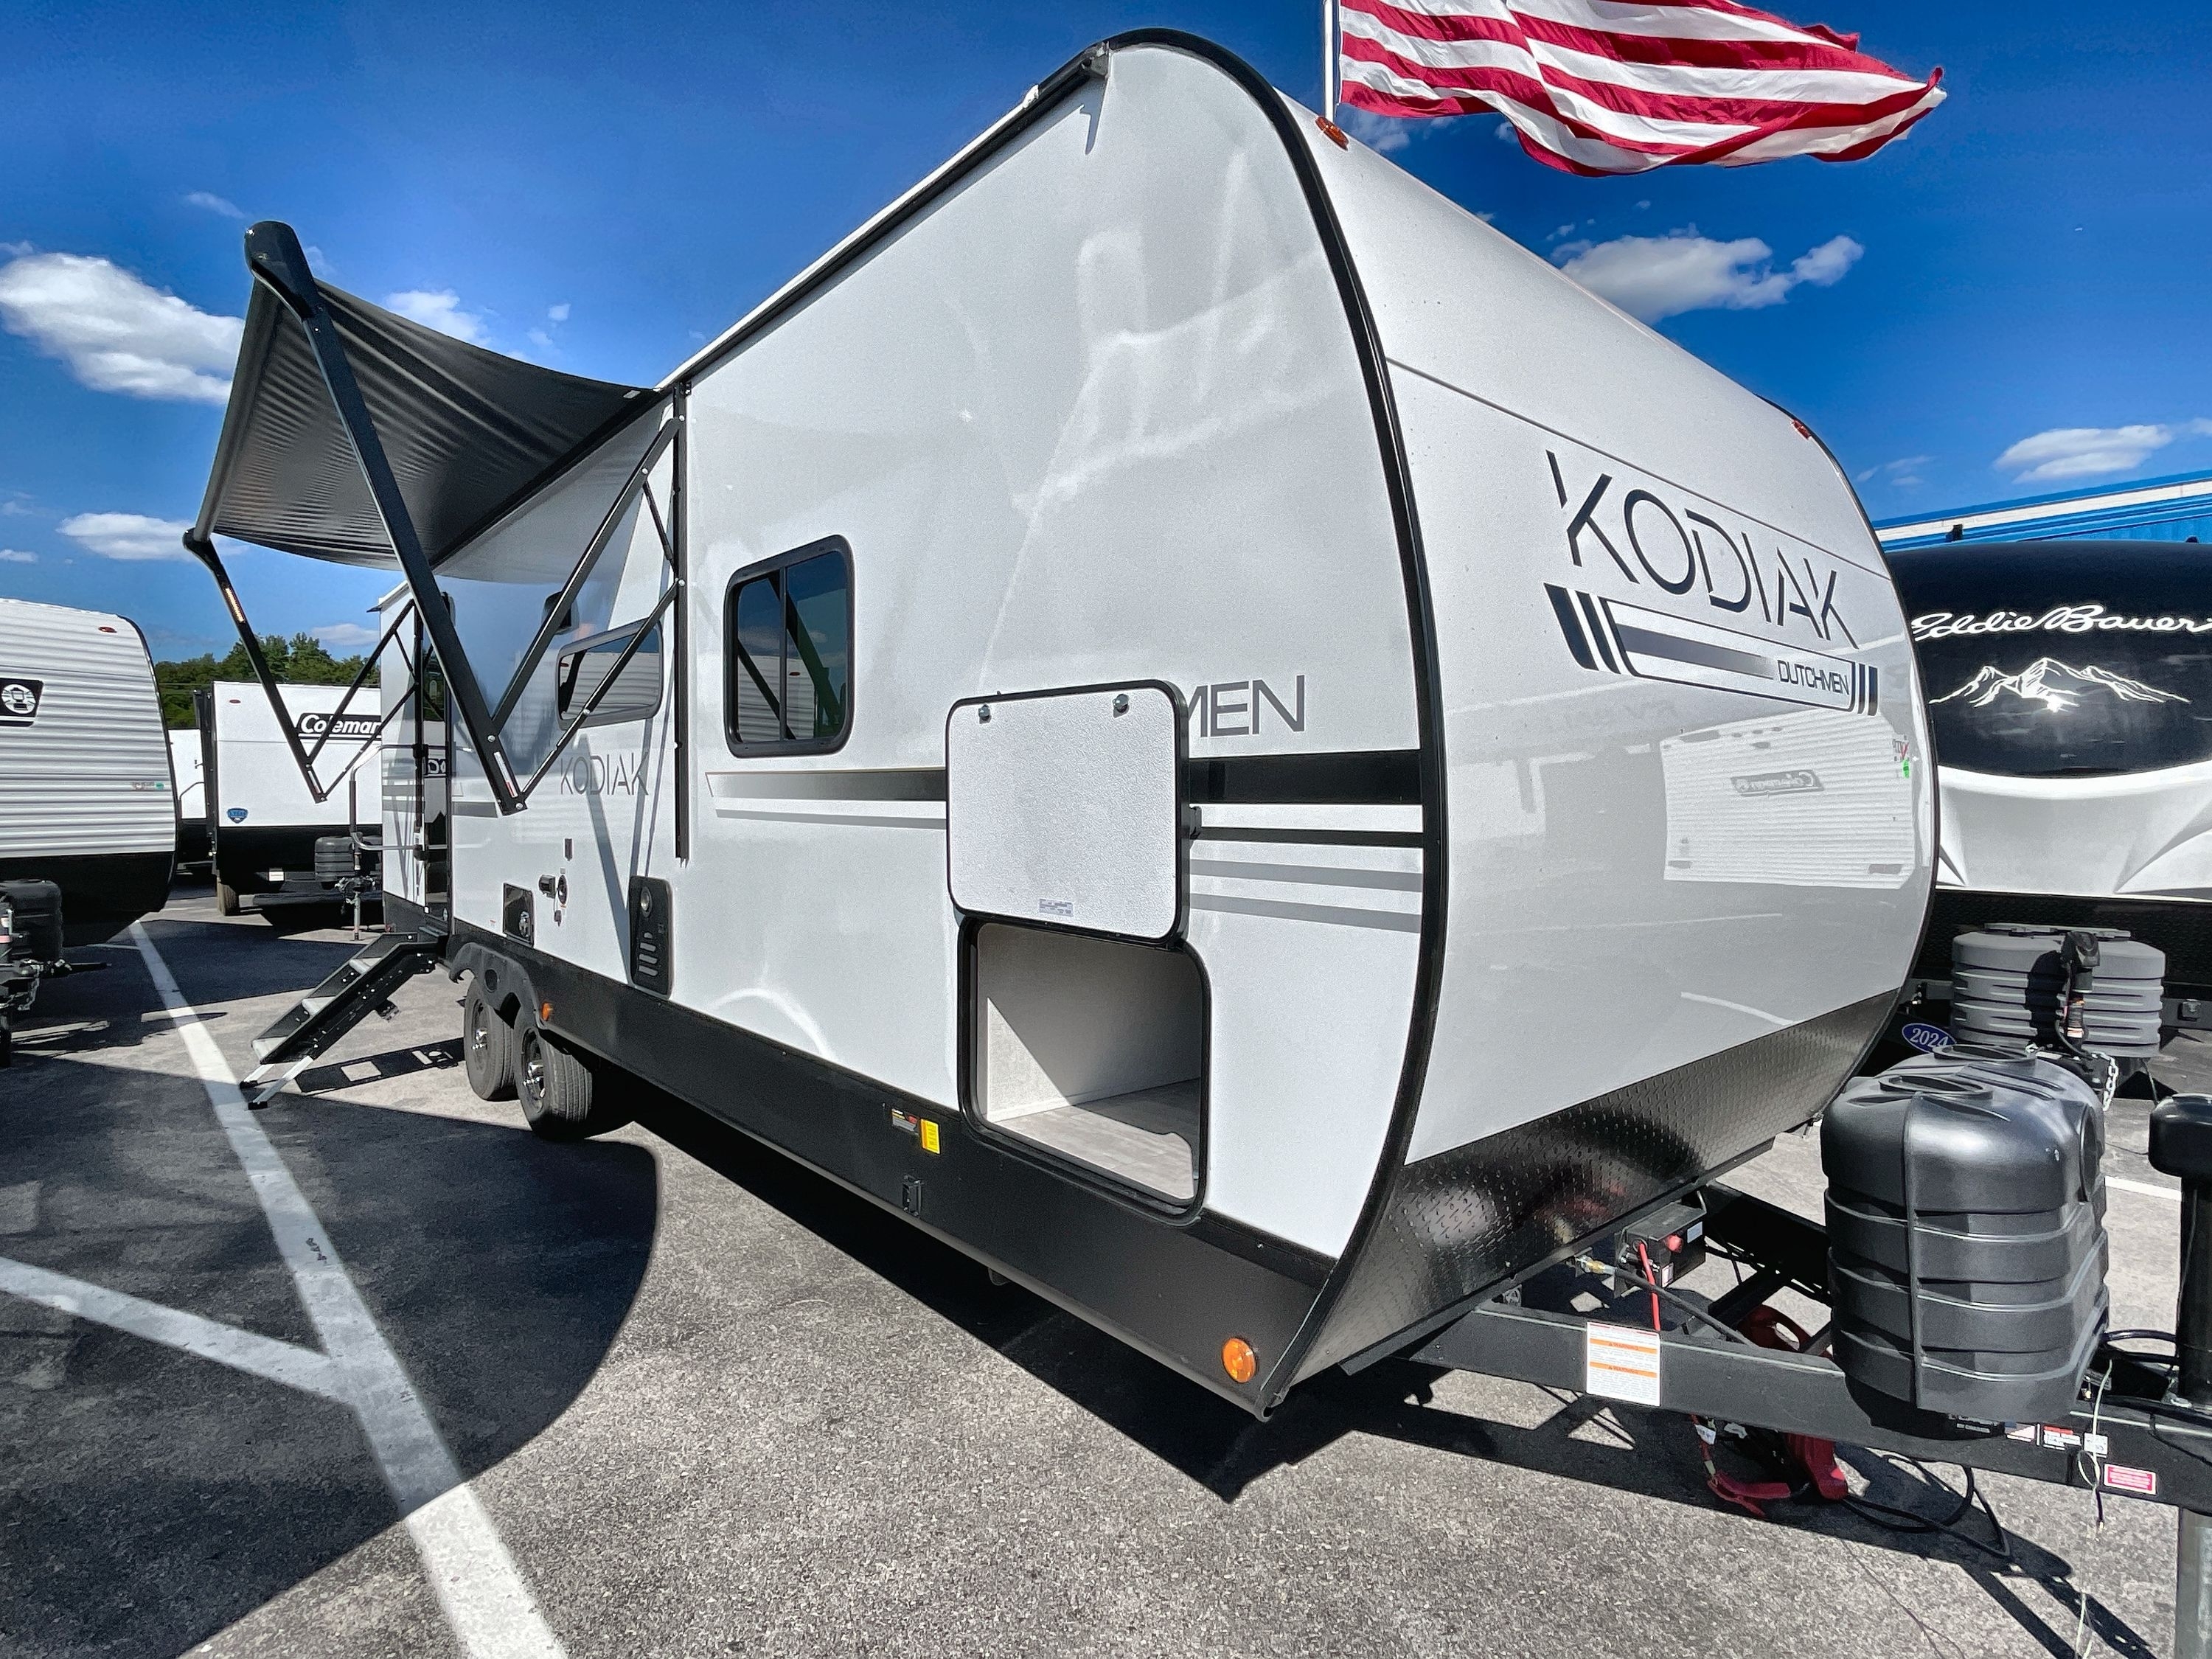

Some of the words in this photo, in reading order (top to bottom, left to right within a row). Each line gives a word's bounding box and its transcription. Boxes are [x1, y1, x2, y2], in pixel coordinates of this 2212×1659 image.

[1545, 449, 1859, 650] KODIAK
[1911, 611, 2037, 641] Eddie
[2044, 604, 2212, 633] Bauer
[1777, 659, 1850, 695] DUTCHMEN
[560, 752, 649, 796] KODIAK
